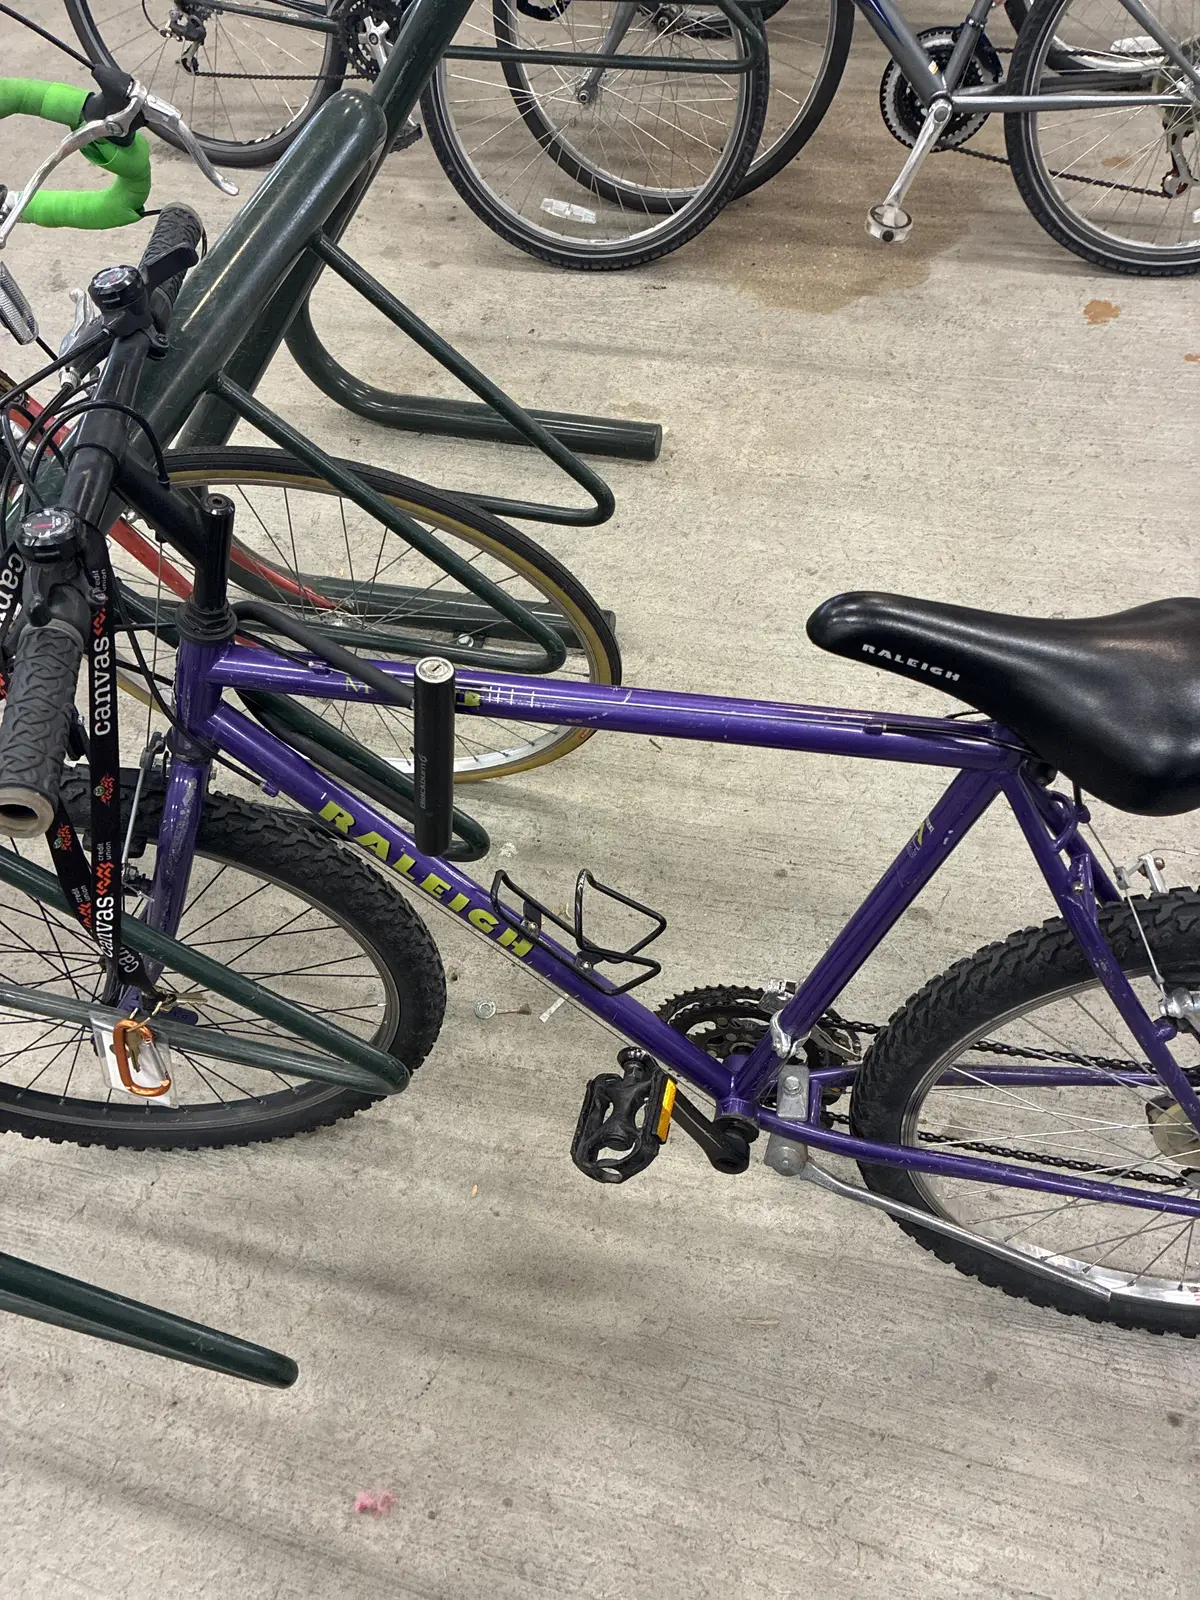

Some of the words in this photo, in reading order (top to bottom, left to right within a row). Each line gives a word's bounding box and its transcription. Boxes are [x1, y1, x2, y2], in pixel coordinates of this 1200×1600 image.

[0, 552, 24, 628] can
[93, 636, 111, 737] canvas
[861, 643, 961, 682] RALEIGH
[319, 801, 534, 957] RALEIGH
[96, 896, 114, 958] canvas
